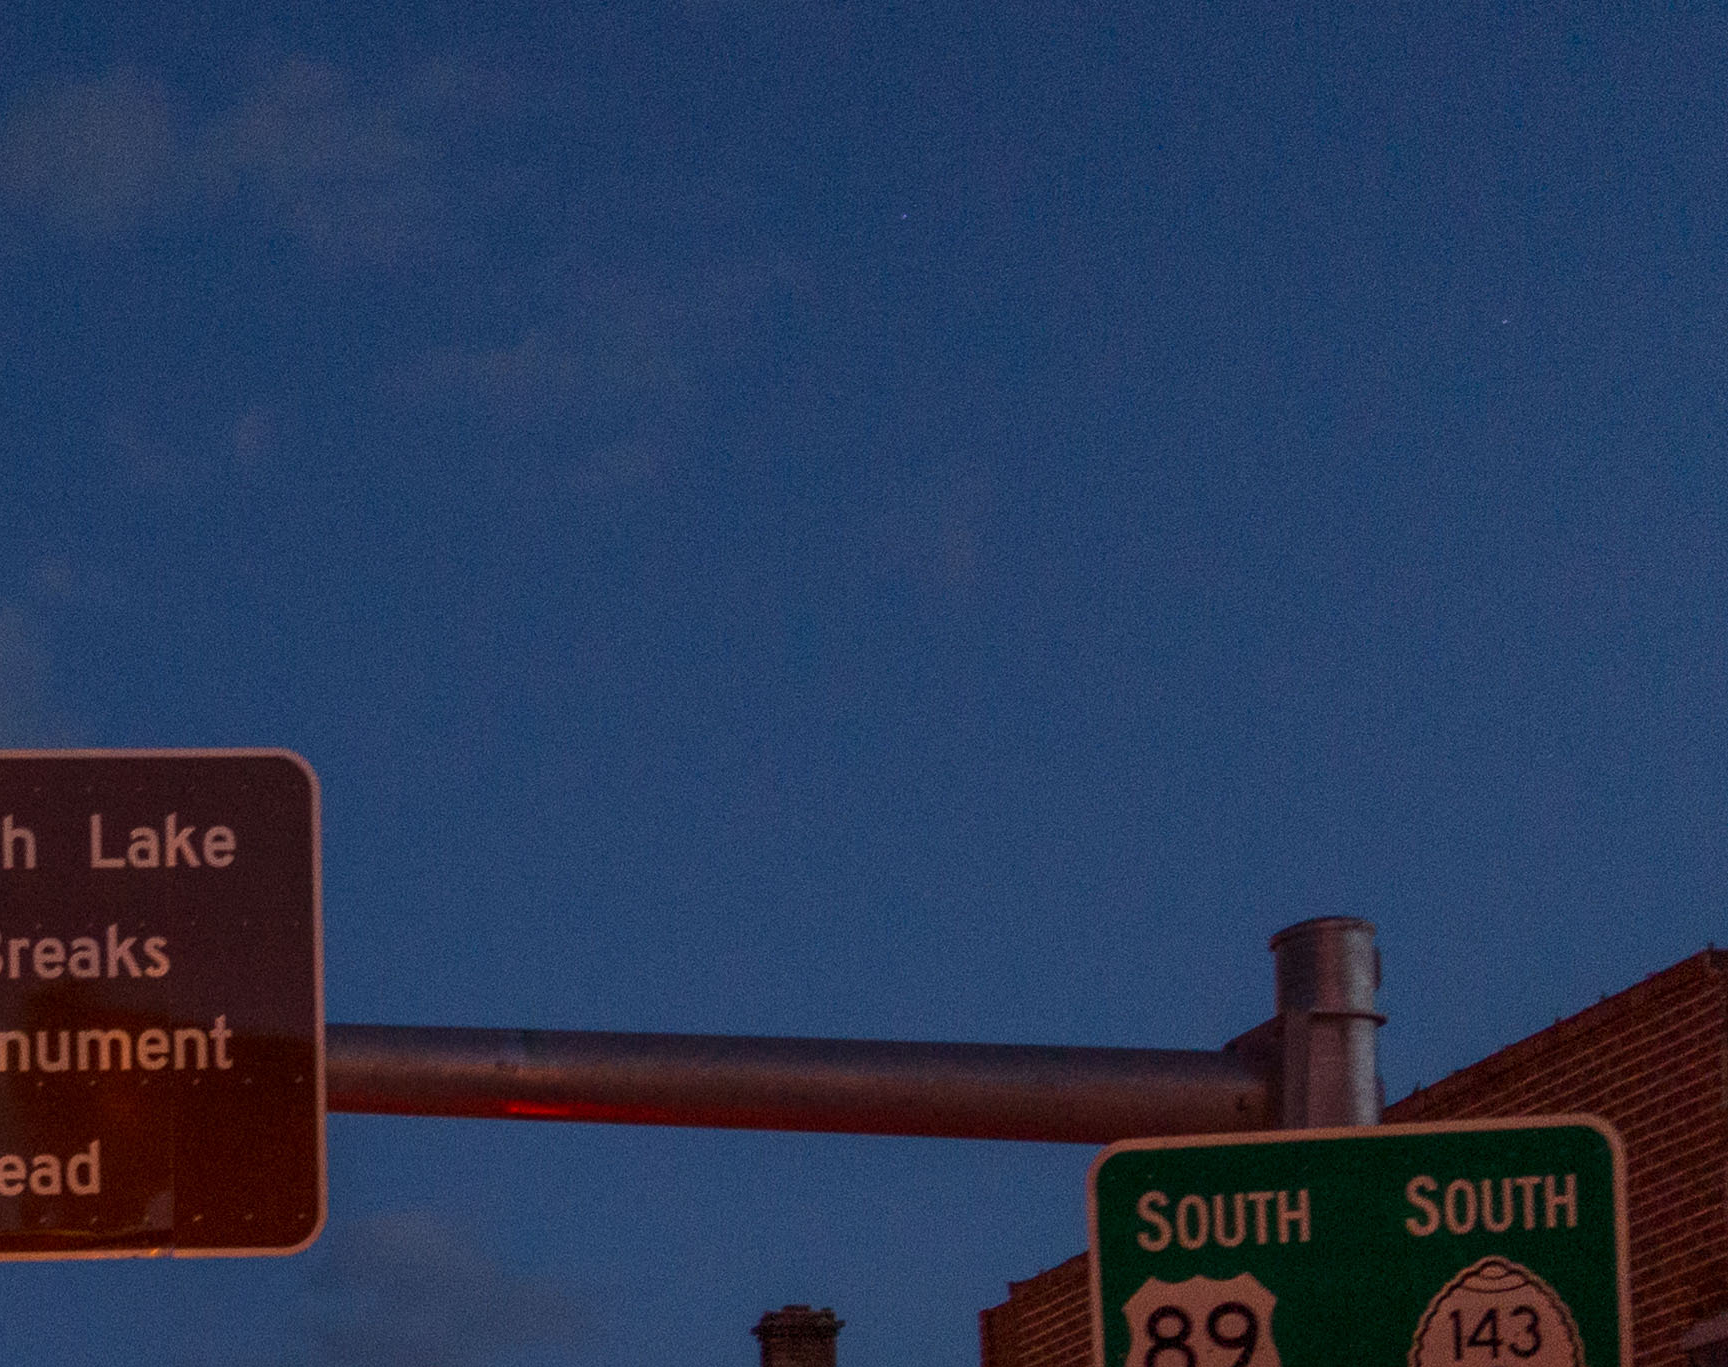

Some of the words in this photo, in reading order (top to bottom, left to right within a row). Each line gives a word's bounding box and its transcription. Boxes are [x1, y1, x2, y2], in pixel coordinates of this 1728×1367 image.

[90, 813, 236, 868] Lake
[1135, 1187, 1313, 1253] SOUTH
[1404, 1172, 1579, 1238] SOUTH
[1448, 1305, 1542, 1362] 143
